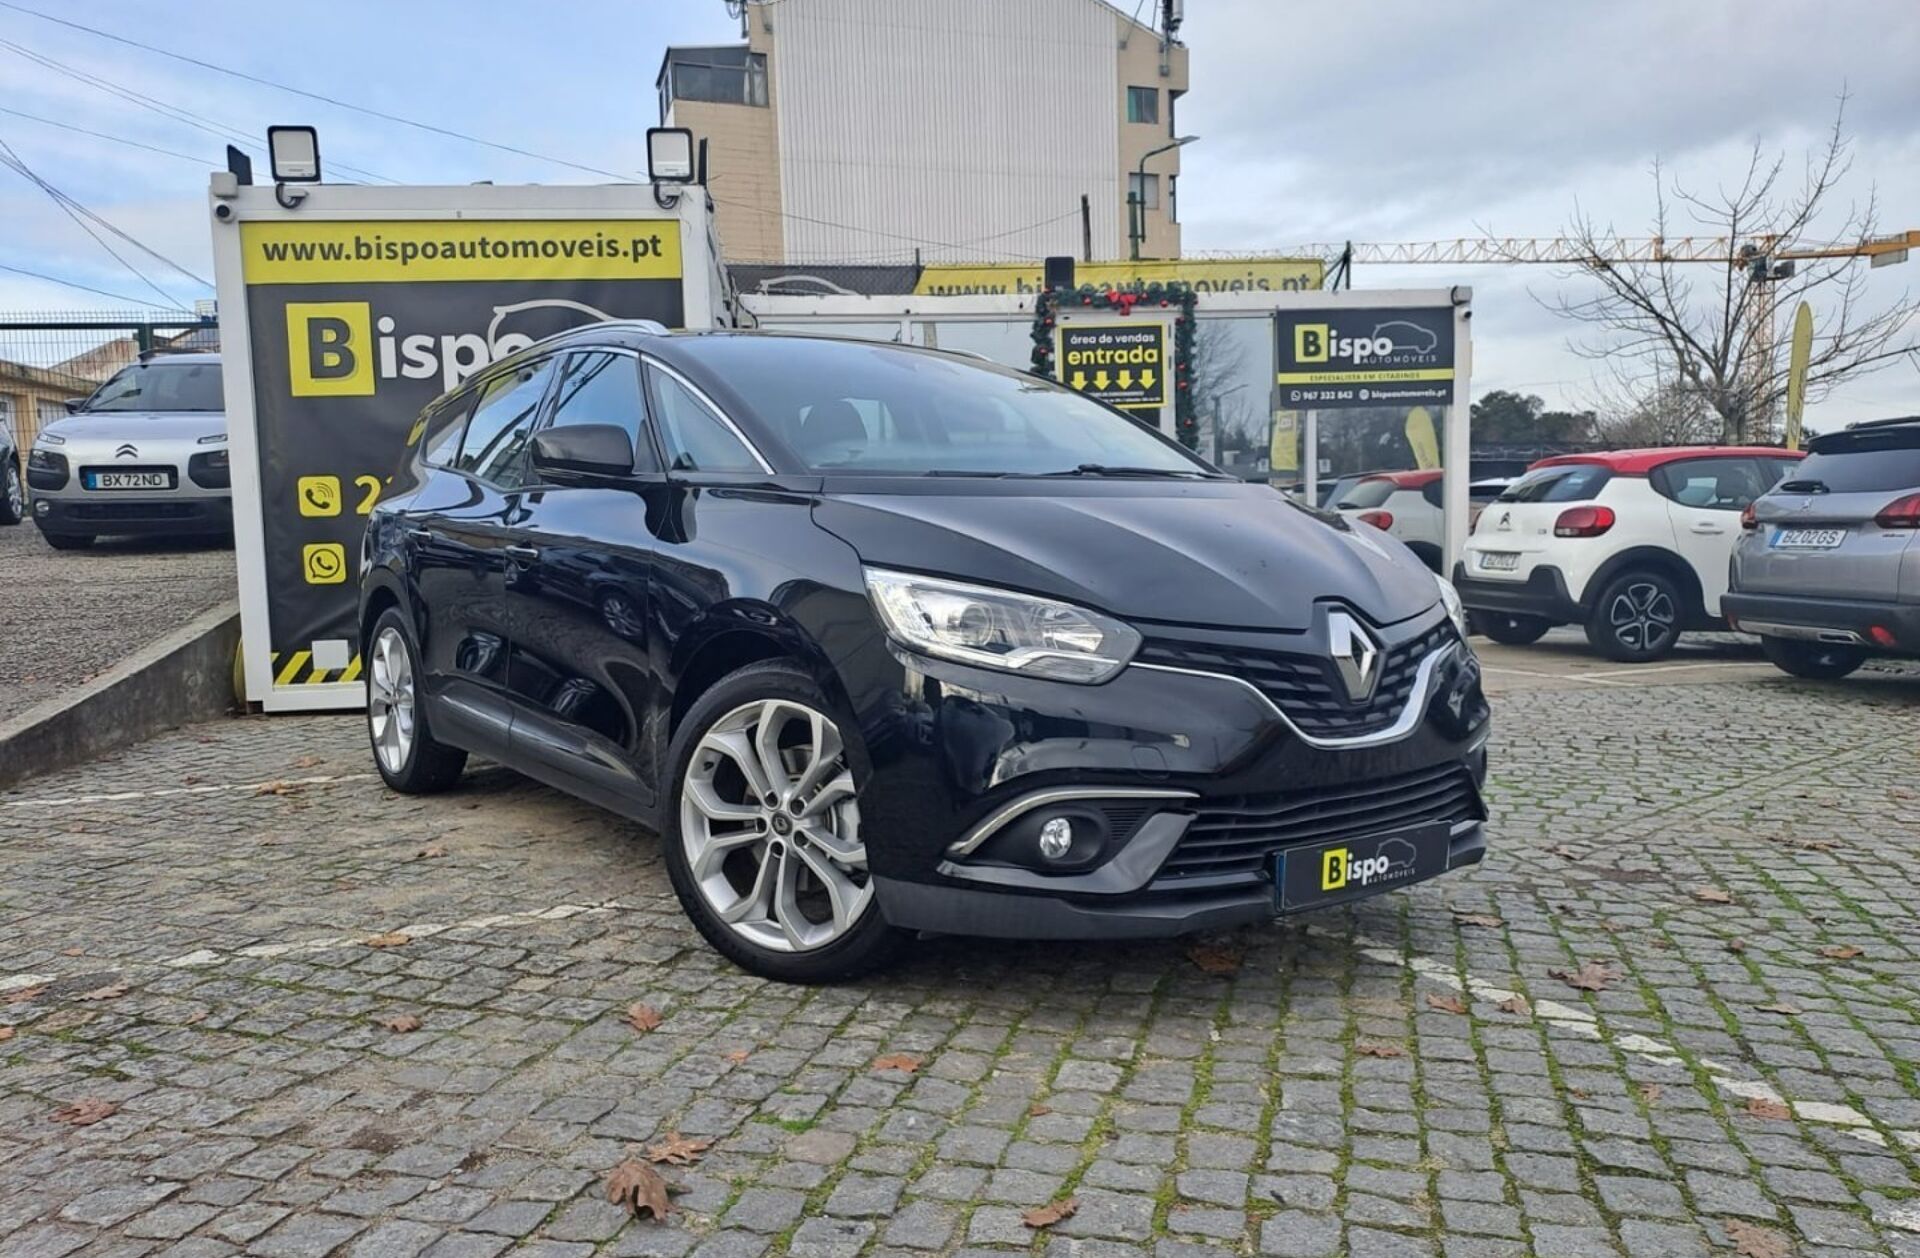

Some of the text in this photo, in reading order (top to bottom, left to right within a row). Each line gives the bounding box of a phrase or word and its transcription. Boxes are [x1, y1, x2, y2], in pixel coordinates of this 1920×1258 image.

[262, 231, 662, 265] www.bispoautomoveis.pt
[1067, 344, 1158, 365] entrada
[1098, 333, 1113, 343] de
[1115, 332, 1156, 343] vendas
[1302, 328, 1393, 365] Bispo
[1327, 852, 1390, 886] Bispo
